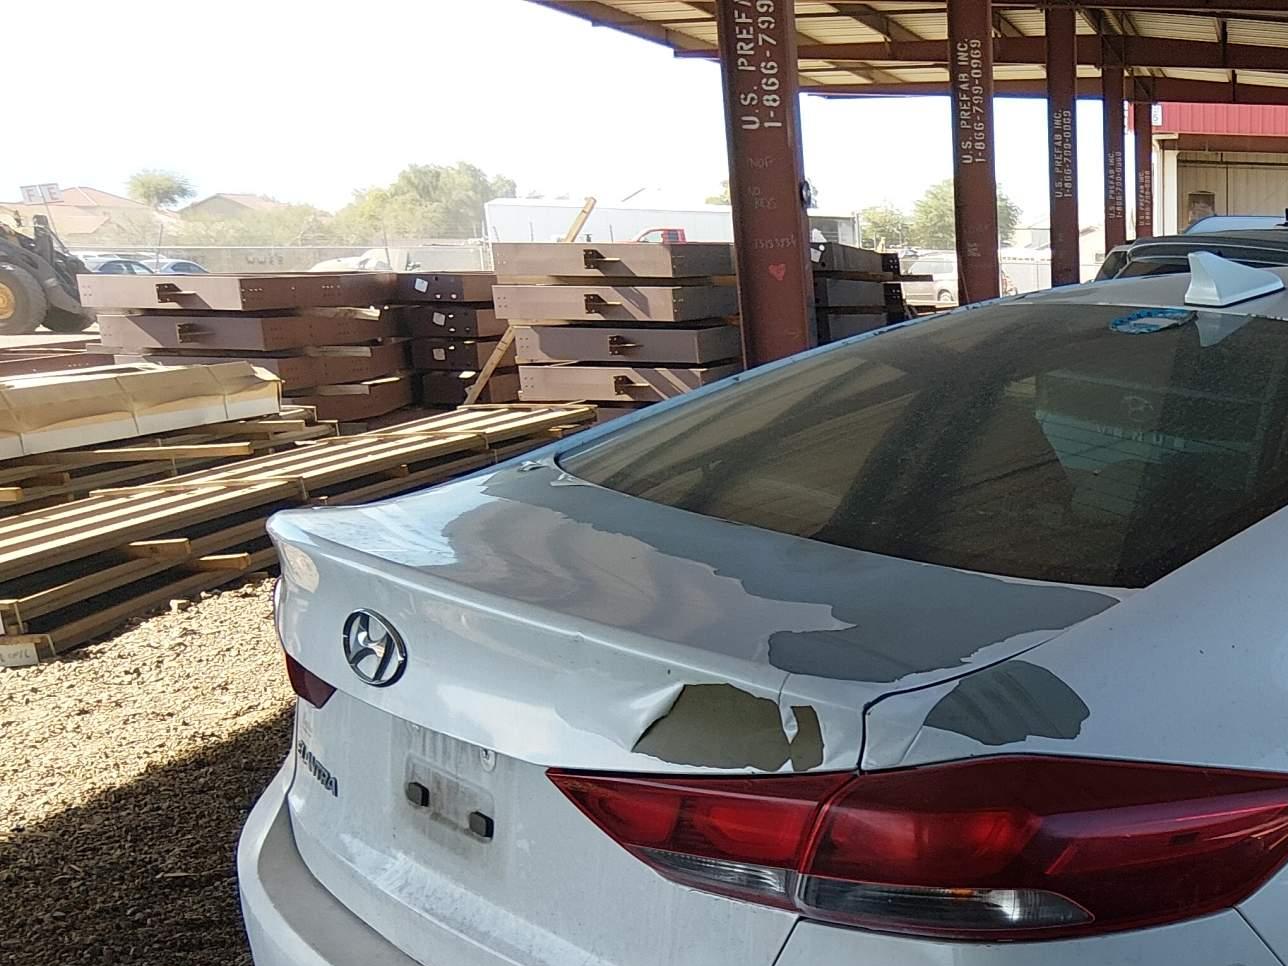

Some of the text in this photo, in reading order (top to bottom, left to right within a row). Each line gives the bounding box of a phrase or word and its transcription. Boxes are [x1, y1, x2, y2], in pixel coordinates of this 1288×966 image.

[740, 86, 760, 130] U.S.
[956, 38, 973, 164] U.S. PREFAB INC.
[1053, 134, 1063, 173] PREFAB
